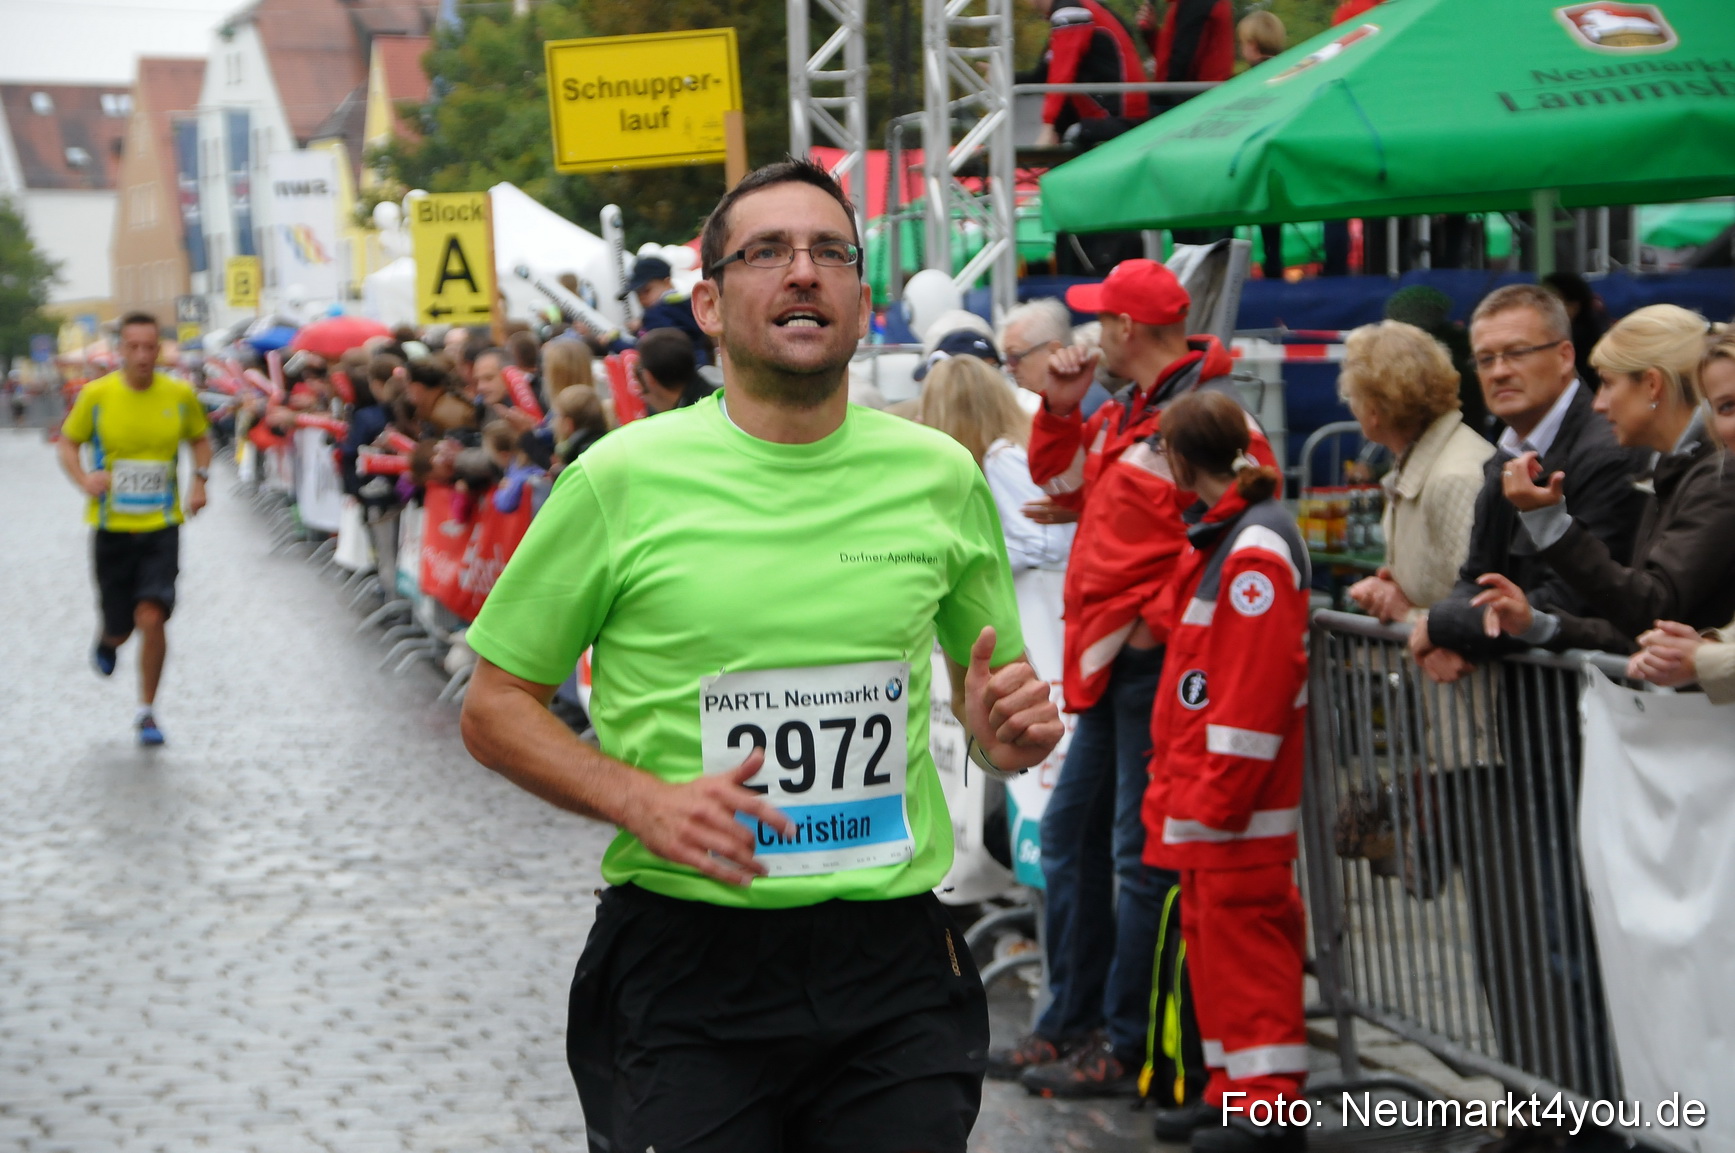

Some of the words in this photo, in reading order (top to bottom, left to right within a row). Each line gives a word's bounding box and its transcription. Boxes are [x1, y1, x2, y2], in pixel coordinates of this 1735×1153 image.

[562, 73, 722, 101] Schnupper-
[619, 105, 671, 132] lauf
[418, 199, 484, 222] Block
[432, 233, 480, 295] A
[840, 551, 938, 565] Dorfner-Apotheken
[704, 692, 779, 712] PARTL
[785, 685, 880, 708] Neumarkt
[726, 713, 893, 795] 2972
